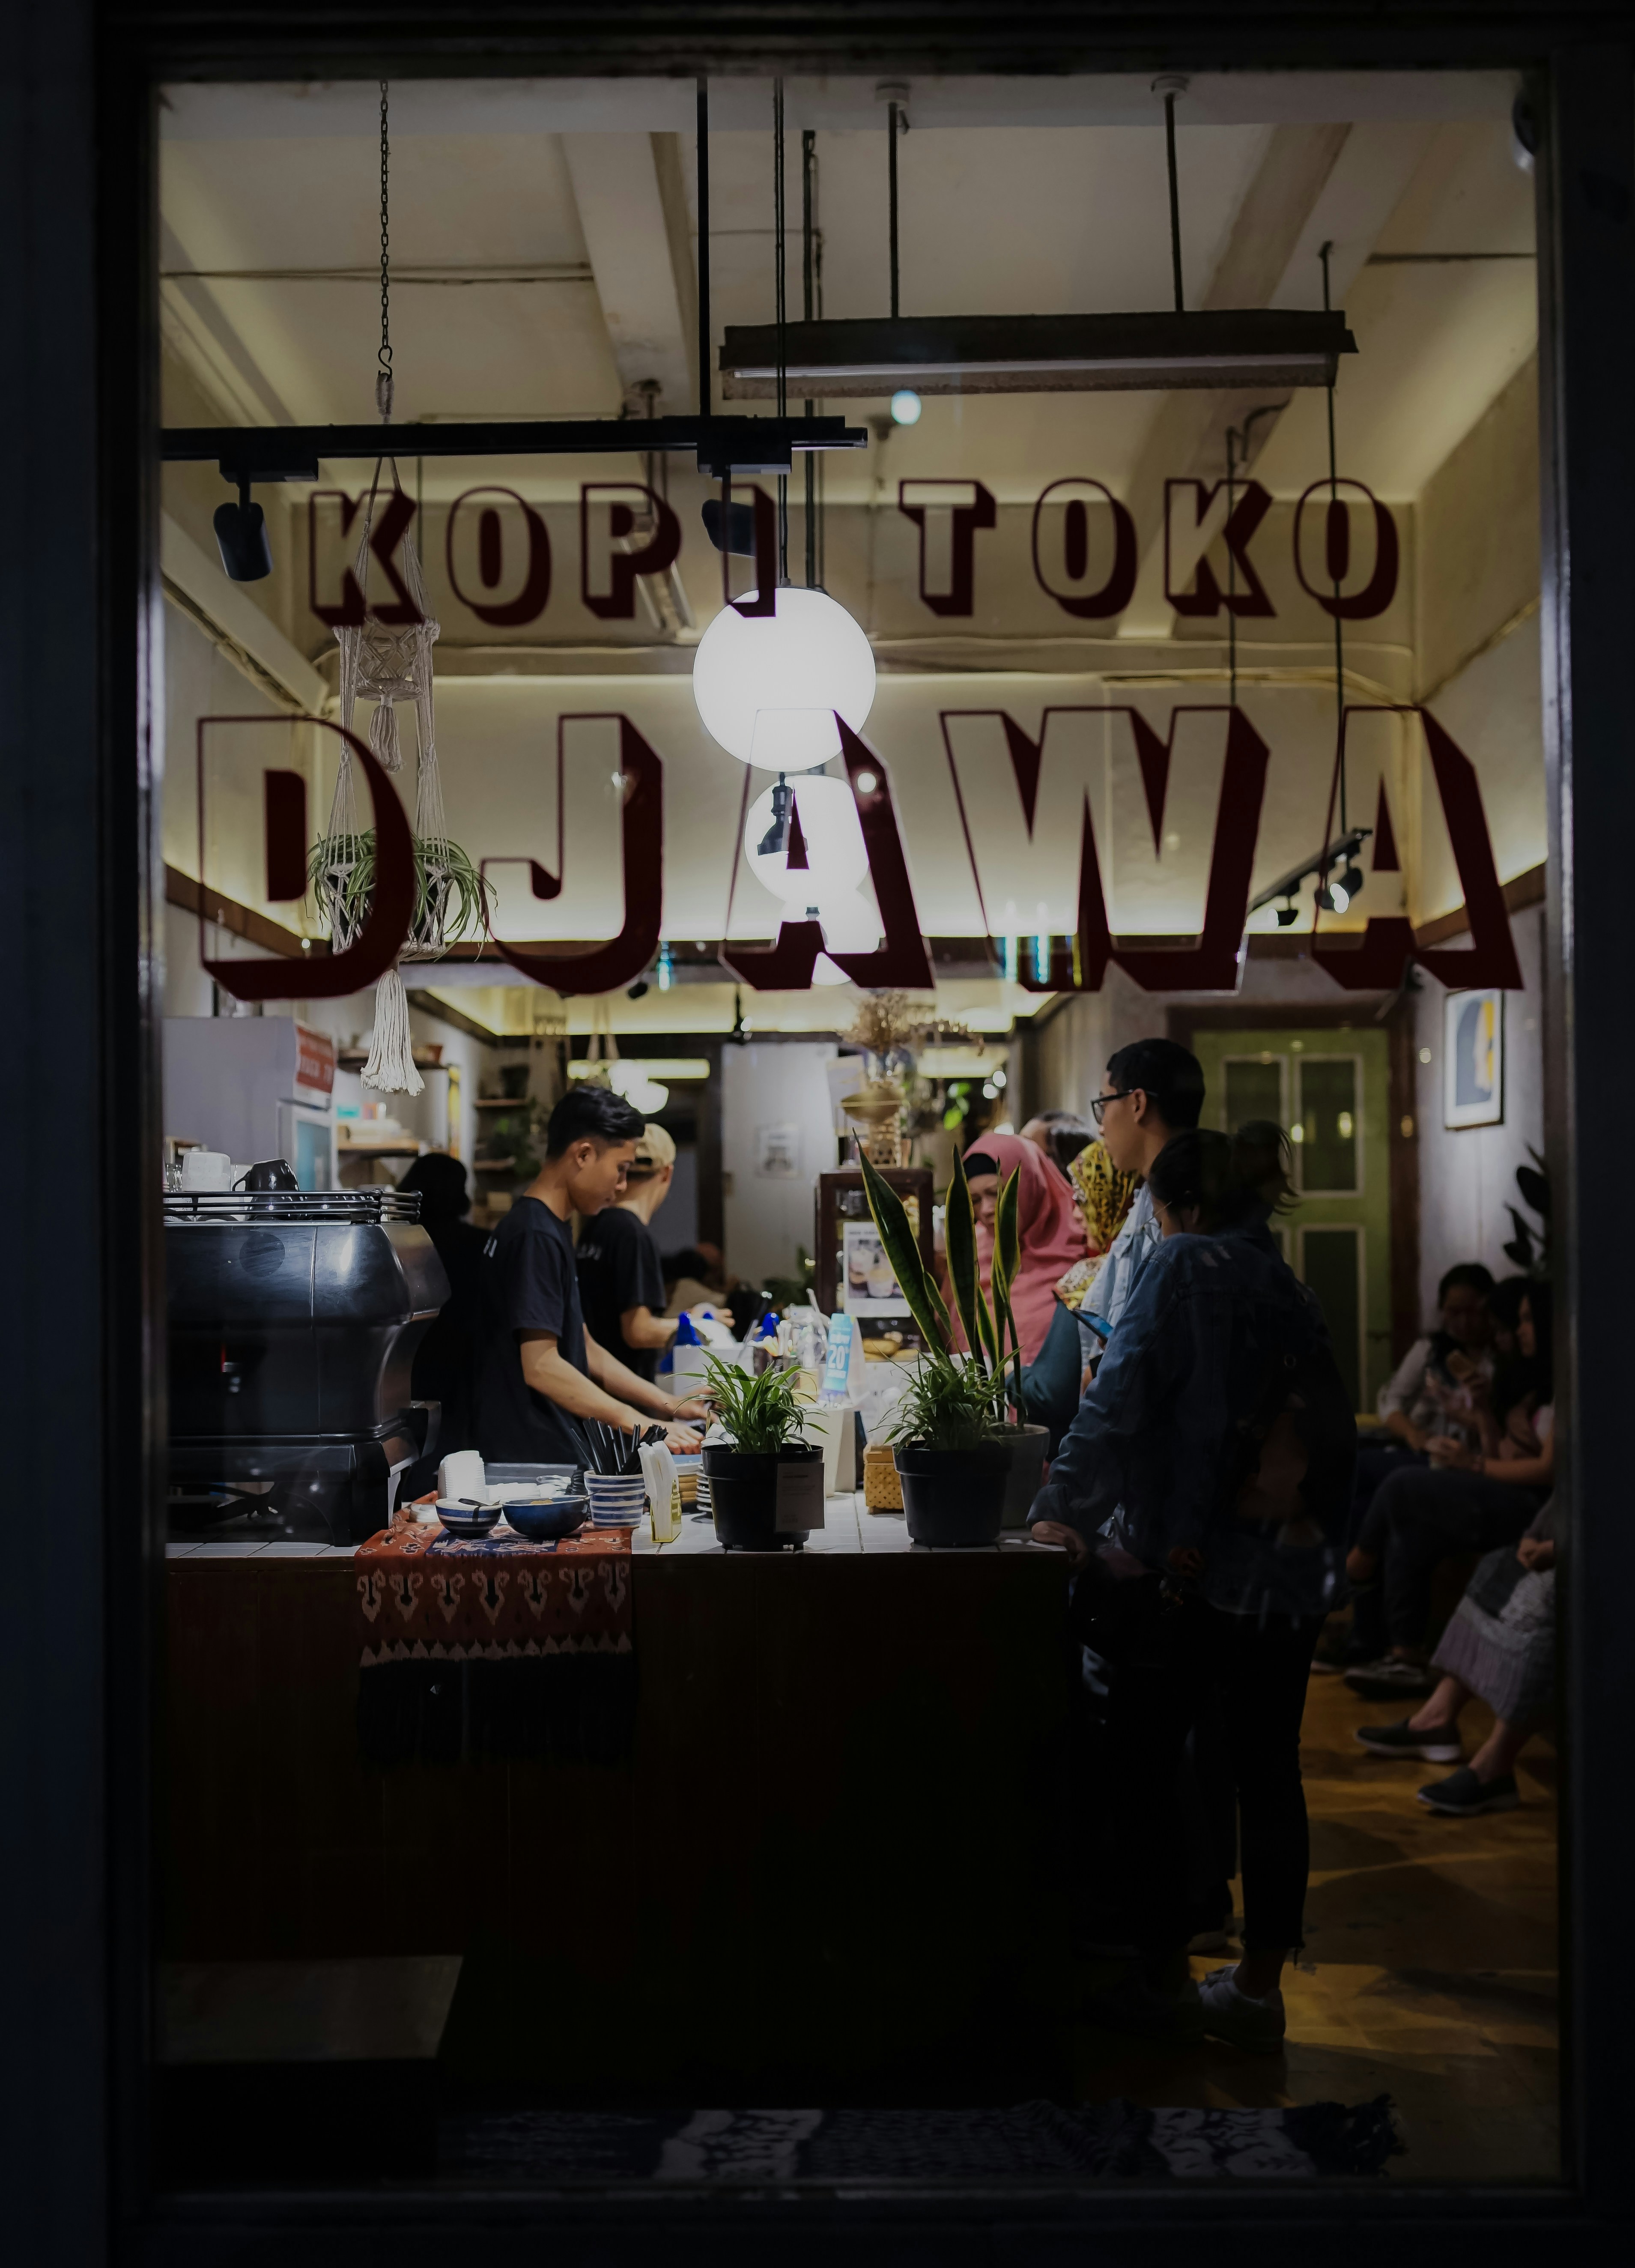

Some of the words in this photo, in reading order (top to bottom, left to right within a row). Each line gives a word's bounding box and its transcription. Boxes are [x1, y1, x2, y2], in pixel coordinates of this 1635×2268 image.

[309, 483, 776, 626] KOPI
[899, 478, 1399, 619] TOKO
[197, 705, 1524, 1001] DJAWA
